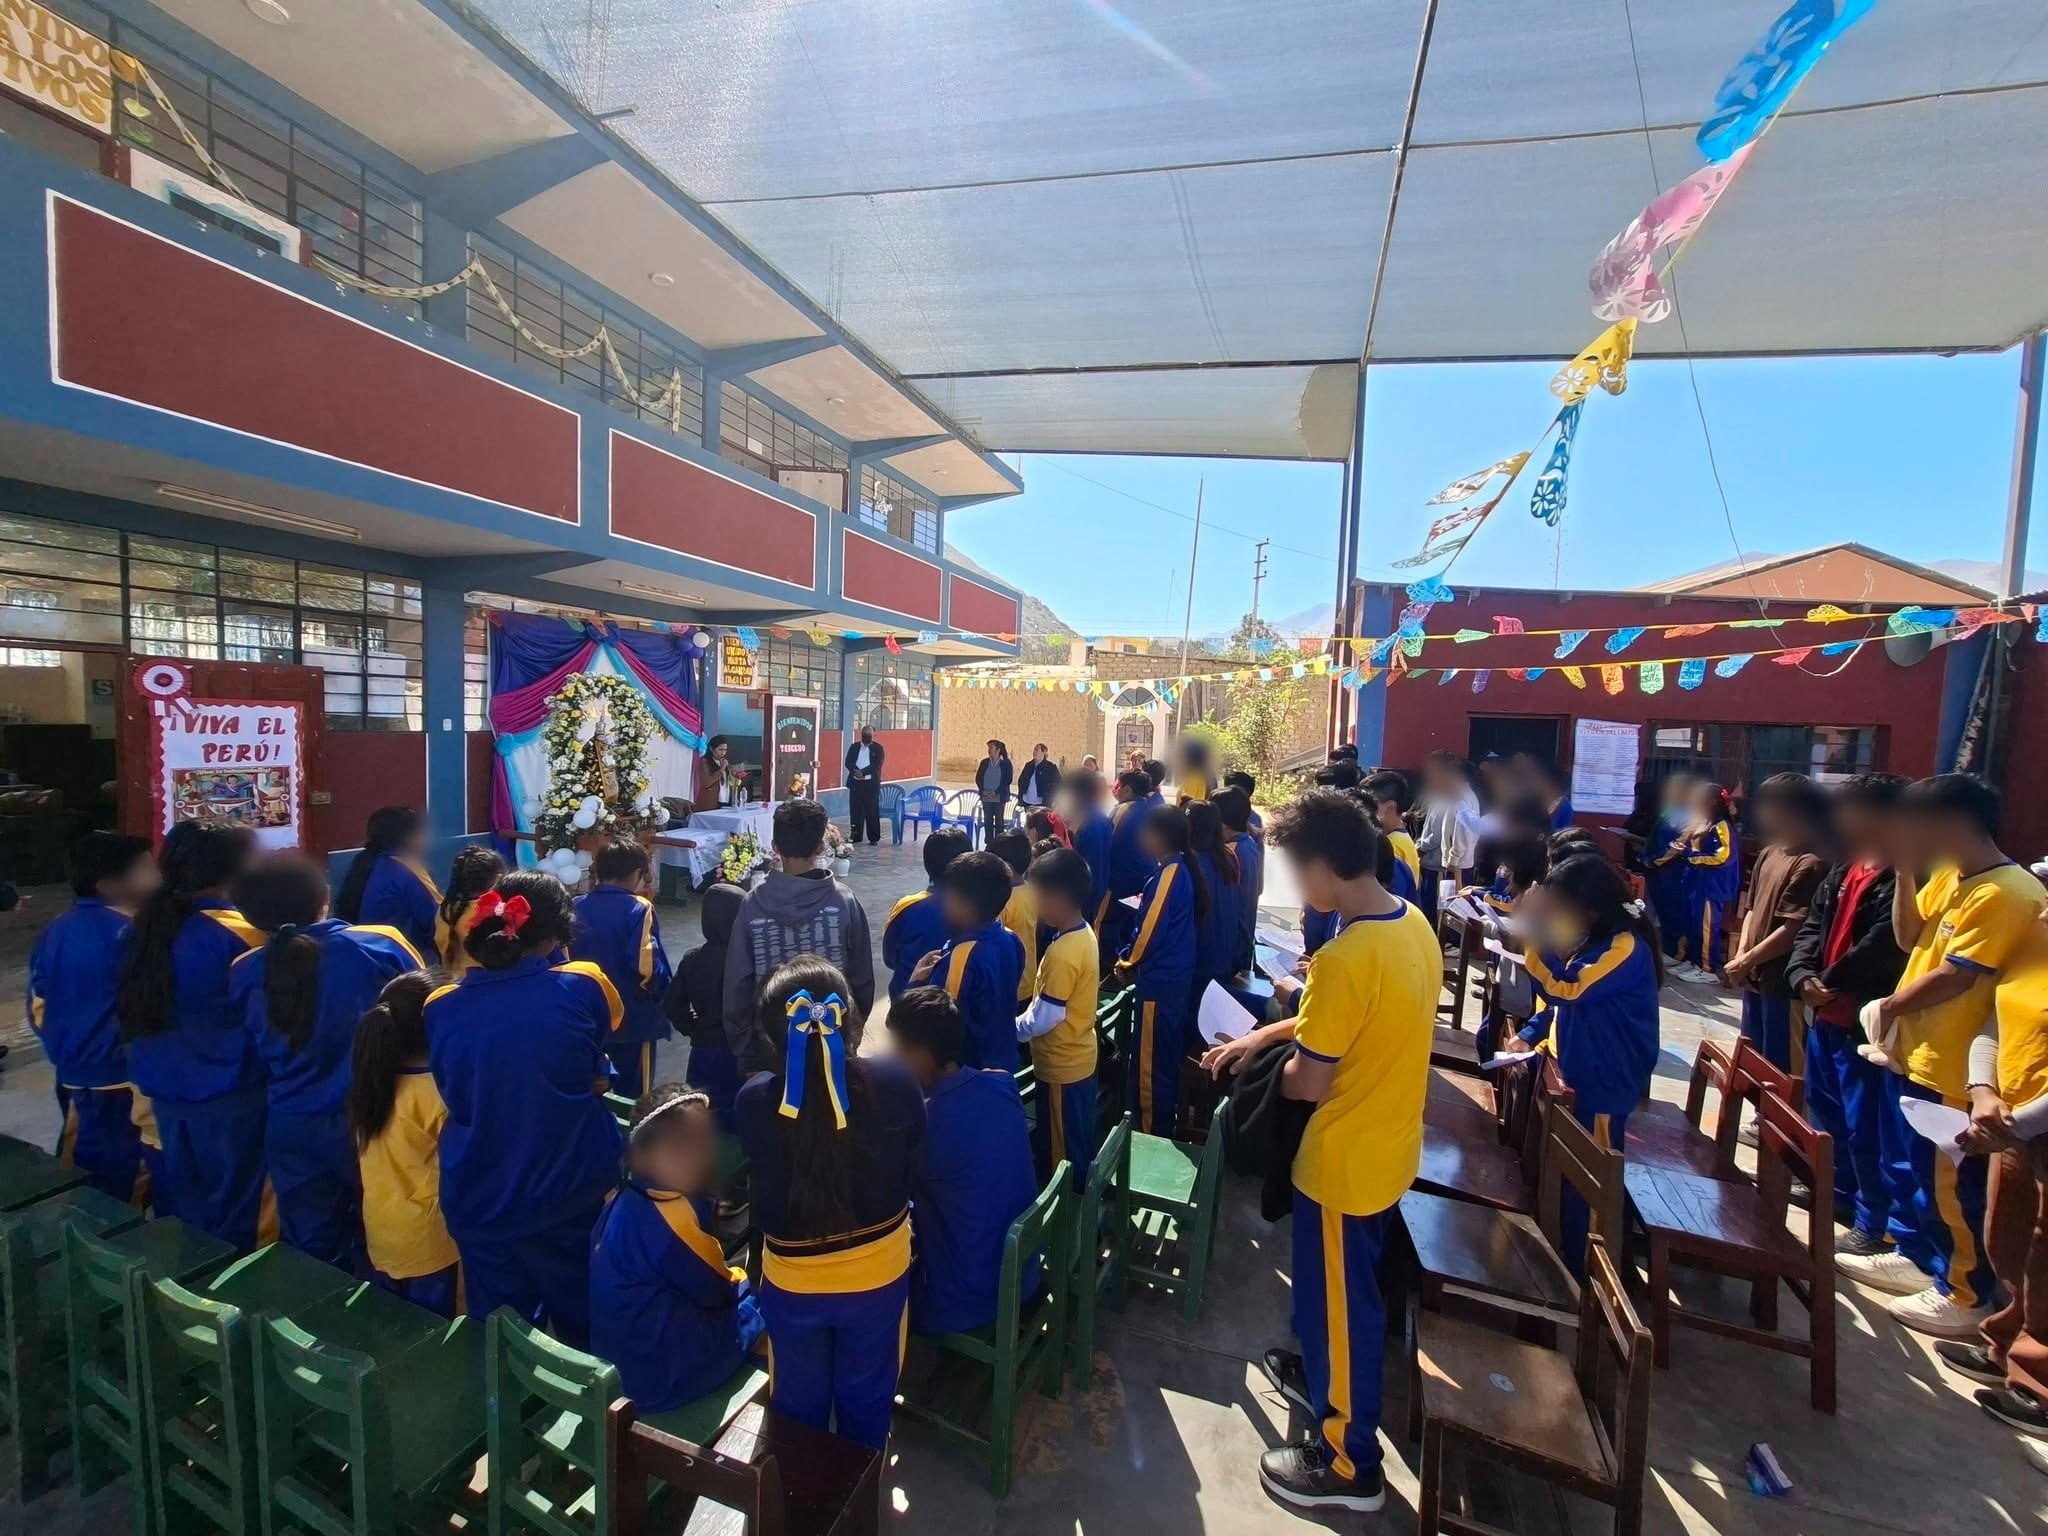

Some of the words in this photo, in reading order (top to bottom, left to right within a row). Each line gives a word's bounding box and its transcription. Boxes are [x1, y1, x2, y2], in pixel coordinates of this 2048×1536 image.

[29, 31, 112, 99] LOS
[0, 45, 106, 124] IVOS
[257, 717, 286, 735] EL
[791, 730, 797, 738] A
[202, 740, 281, 763] PERÚ!
